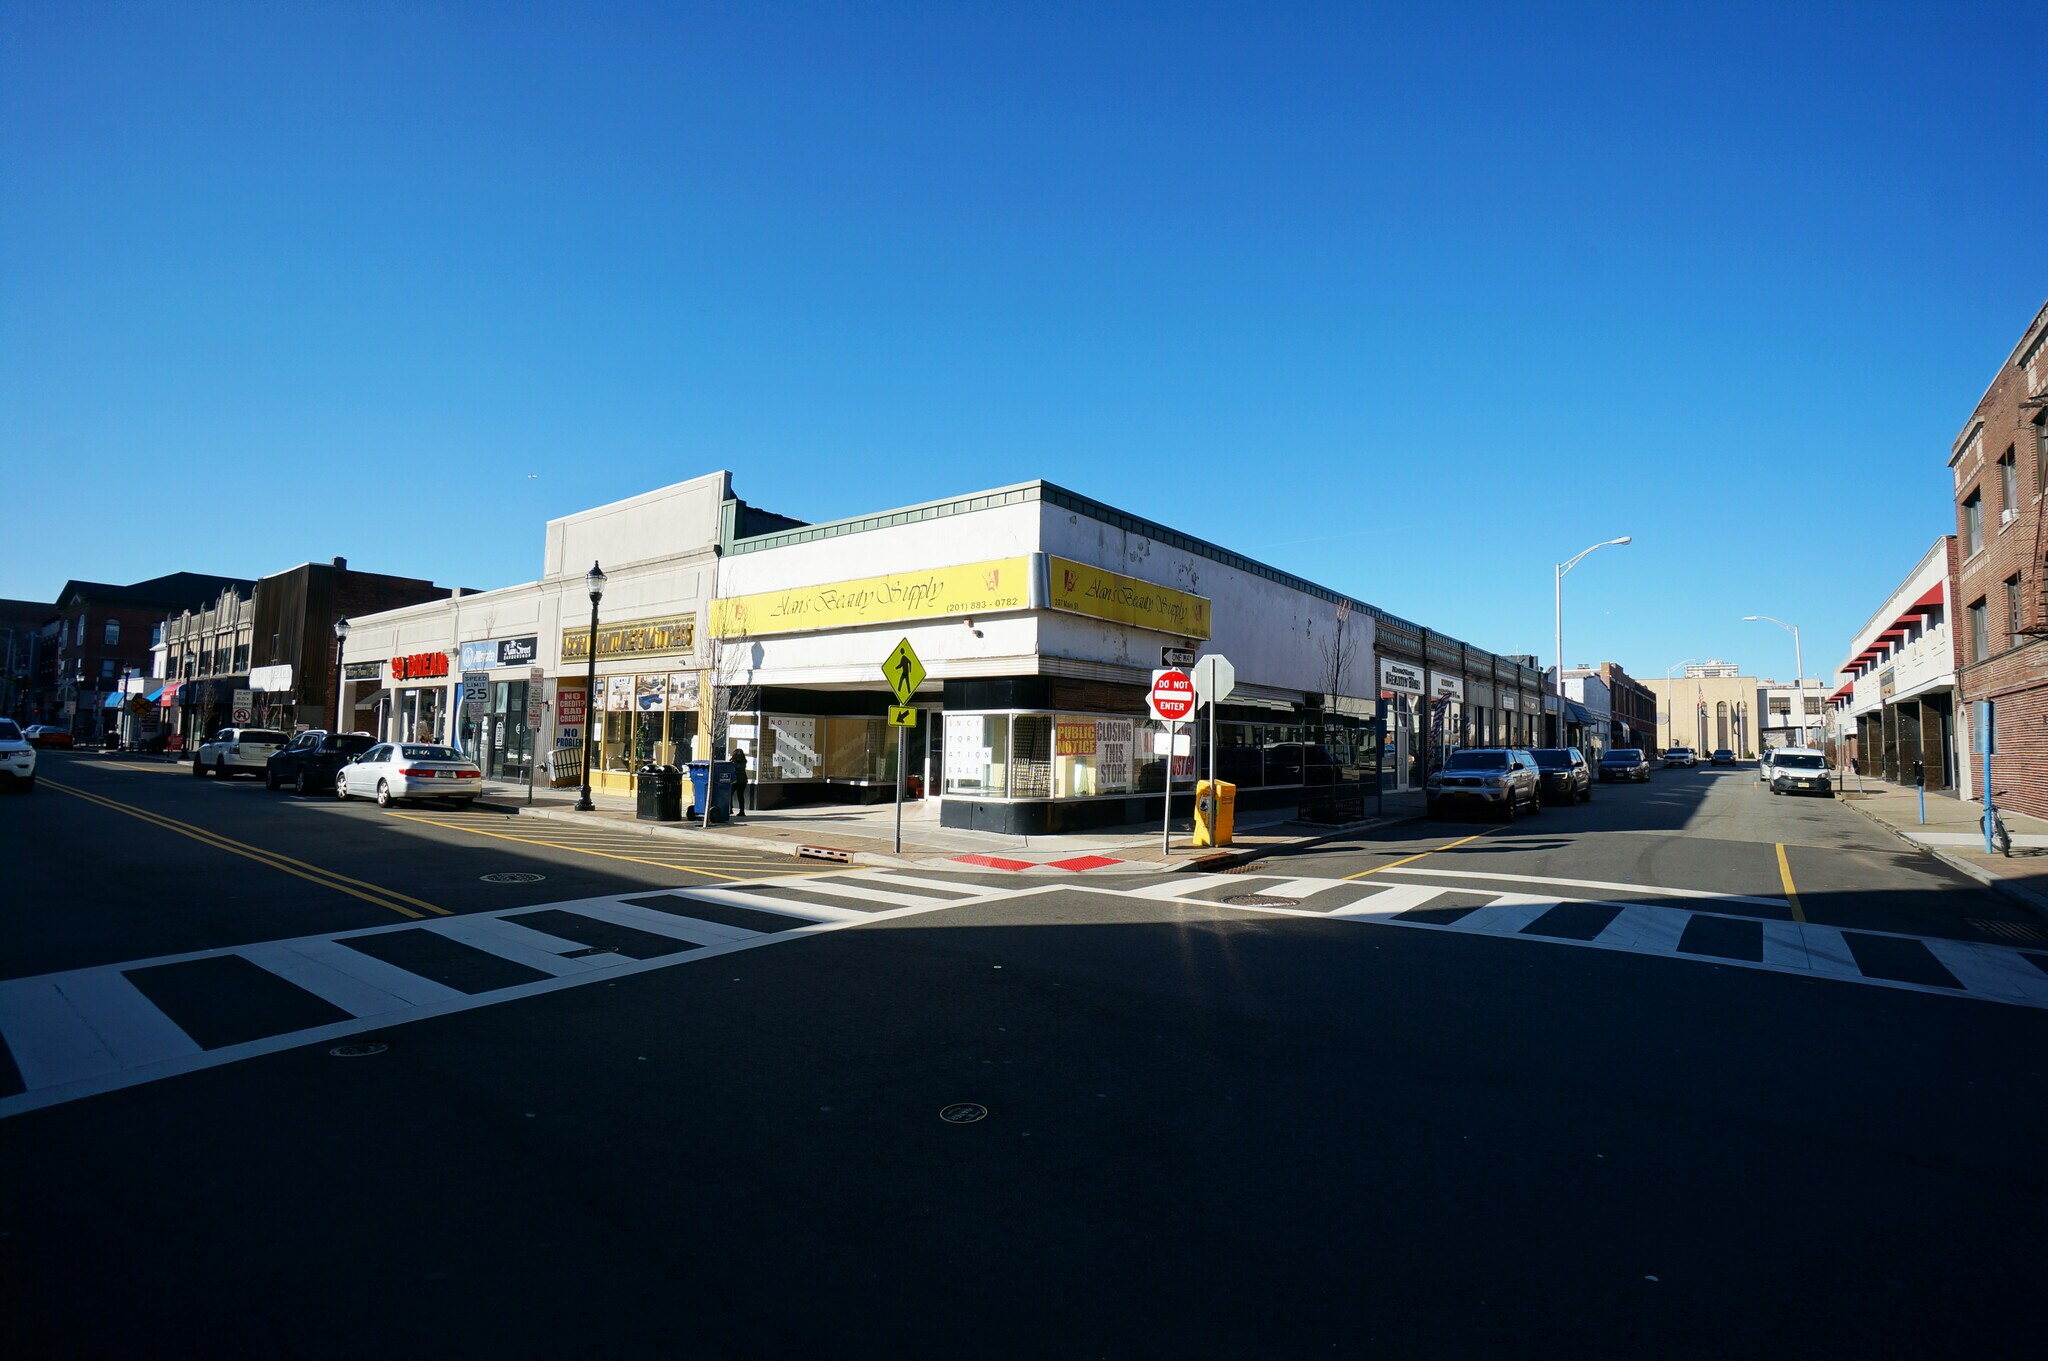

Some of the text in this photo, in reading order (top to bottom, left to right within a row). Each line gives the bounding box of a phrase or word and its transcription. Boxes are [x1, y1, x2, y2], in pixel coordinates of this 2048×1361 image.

[771, 576, 944, 616] Alan's Beauty Supply
[1085, 578, 1188, 624] Alan's Beauty Supply
[946, 603, 968, 613] (201)
[970, 600, 987, 610] 883
[994, 597, 1018, 608] 0782
[1171, 653, 1193, 662] ONE WAY
[407, 652, 449, 679] DREAM
[1158, 680, 1189, 689] DO NOT
[466, 688, 487, 699] 25
[564, 692, 581, 700] NO
[564, 708, 582, 716] BAD
[1160, 702, 1185, 711] ENTER
[564, 729, 578, 738] NO
[1057, 726, 1095, 739] PUBLIC
[1097, 721, 1131, 741] CLOSING
[1057, 740, 1095, 754] NOTICE
[1104, 743, 1124, 763] THIS
[1172, 755, 1194, 776] UST GO
[1101, 764, 1127, 784] STORE
